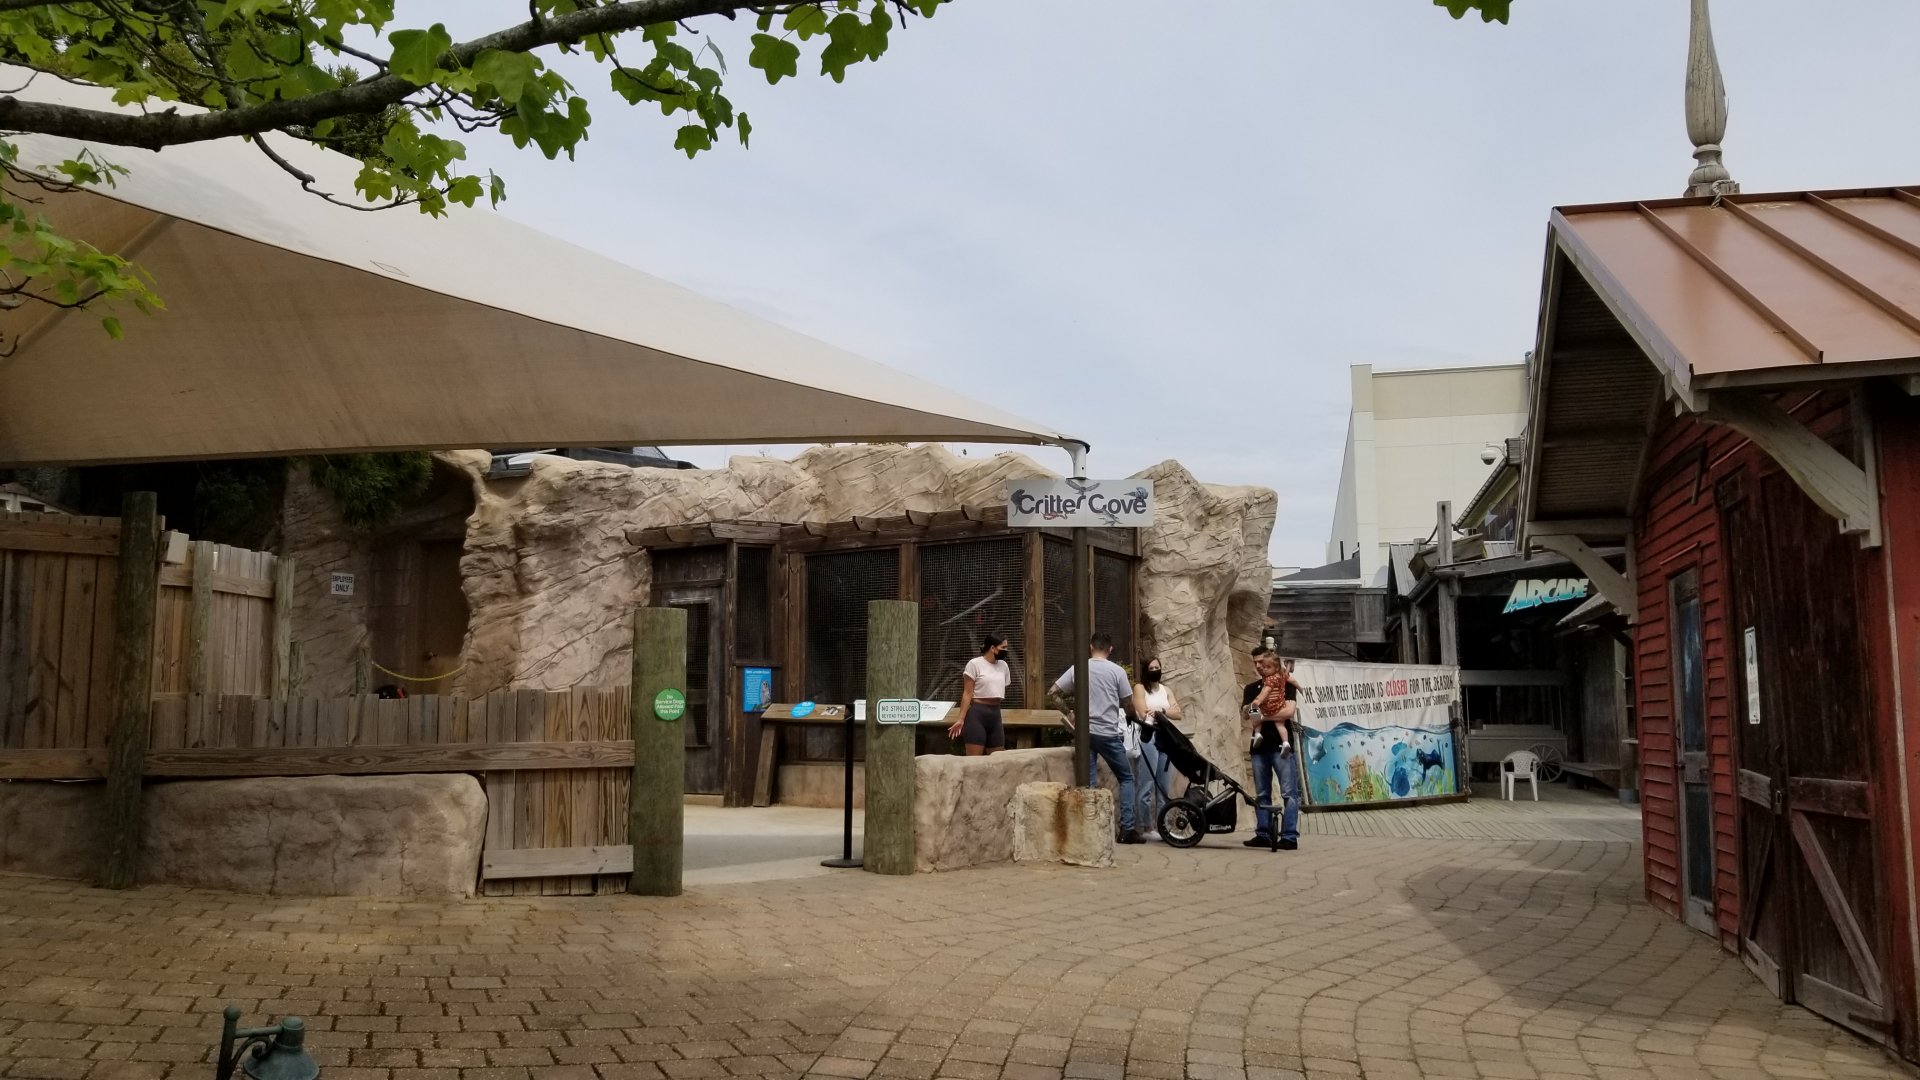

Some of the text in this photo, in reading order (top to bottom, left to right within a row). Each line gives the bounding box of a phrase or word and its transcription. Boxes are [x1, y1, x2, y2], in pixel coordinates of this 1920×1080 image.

[1019, 494, 1147, 514] Critter Cove
[332, 575, 353, 584] EMPLOYEES
[335, 584, 349, 592] ONLY
[1502, 578, 1589, 614] ARCADE
[1315, 685, 1335, 703] SHARK
[1335, 684, 1349, 701] REEF
[1350, 682, 1375, 700] LAGOON
[1376, 681, 1383, 697] IS
[1385, 680, 1408, 697] CLOSED
[1409, 678, 1420, 694] FOR
[1421, 676, 1433, 693] THE
[1315, 706, 1328, 719] COME
[1327, 705, 1338, 717] VISIT
[1338, 705, 1347, 717] THE
[1347, 704, 1357, 716] FISH
[1357, 702, 1372, 714] INSIDE
[1372, 701, 1382, 713] AND
[1383, 700, 1402, 712] SNORKEL
[1403, 698, 1414, 710] WITH
[1415, 697, 1422, 708] US
